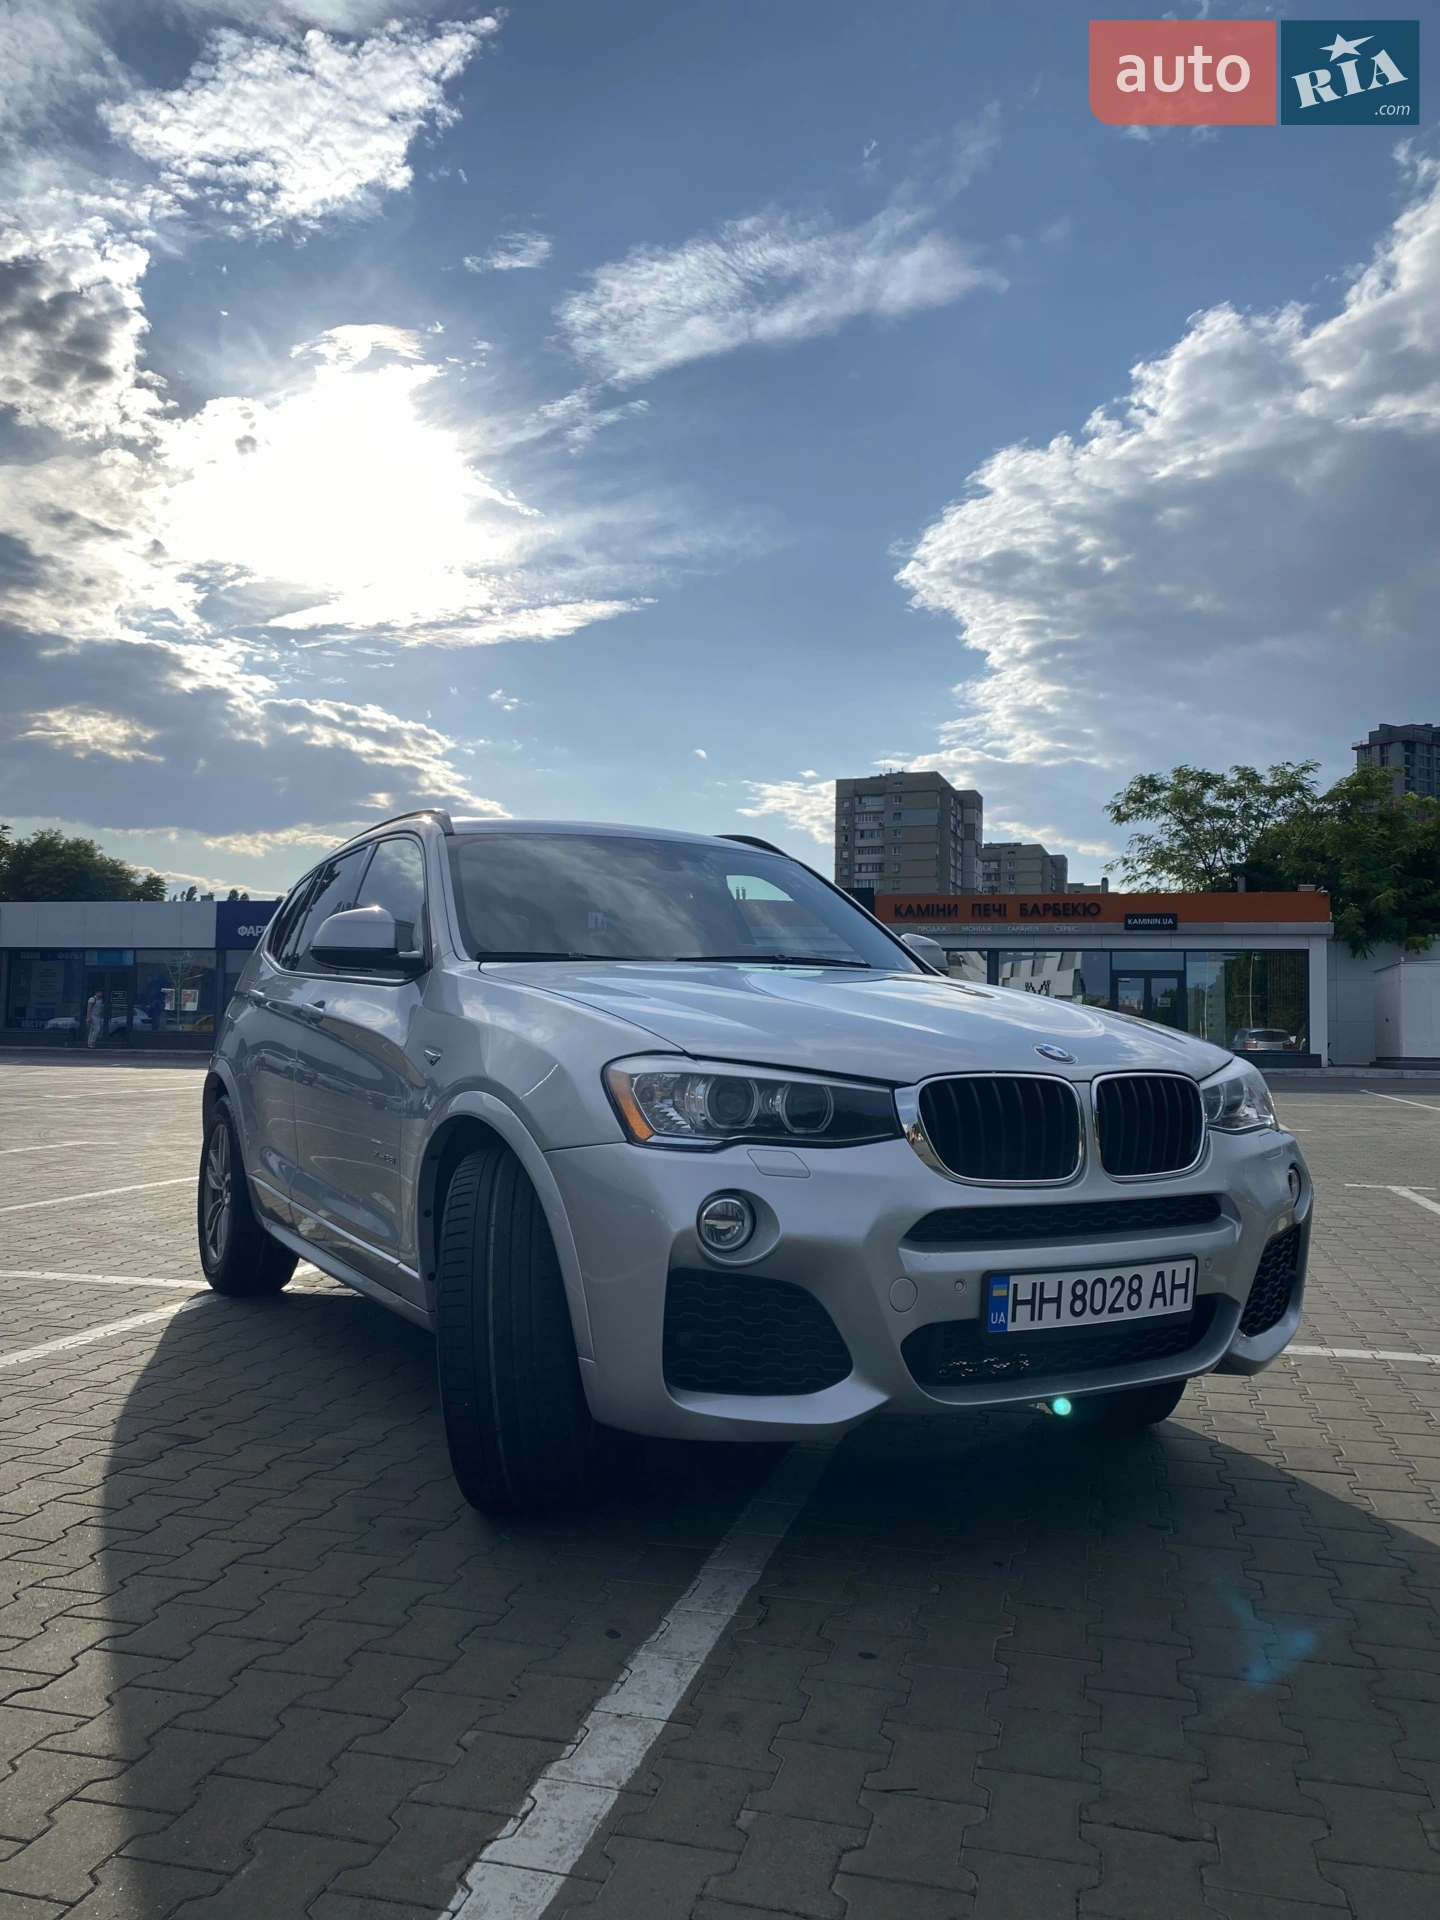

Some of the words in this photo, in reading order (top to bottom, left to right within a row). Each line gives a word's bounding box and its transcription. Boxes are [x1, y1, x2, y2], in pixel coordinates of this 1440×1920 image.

[894, 903, 958, 918] КАМІНИ
[971, 903, 1007, 917] ПЕЧІ
[1019, 902, 1101, 917] БАРБЕКЮ
[237, 925, 267, 937] ФАР
[917, 925, 947, 933] ПРОДАЖ
[1011, 1280, 1063, 1323] HH
[1069, 1273, 1143, 1318] 8028
[1149, 1267, 1191, 1309] AH
[990, 1311, 1006, 1325] UA
